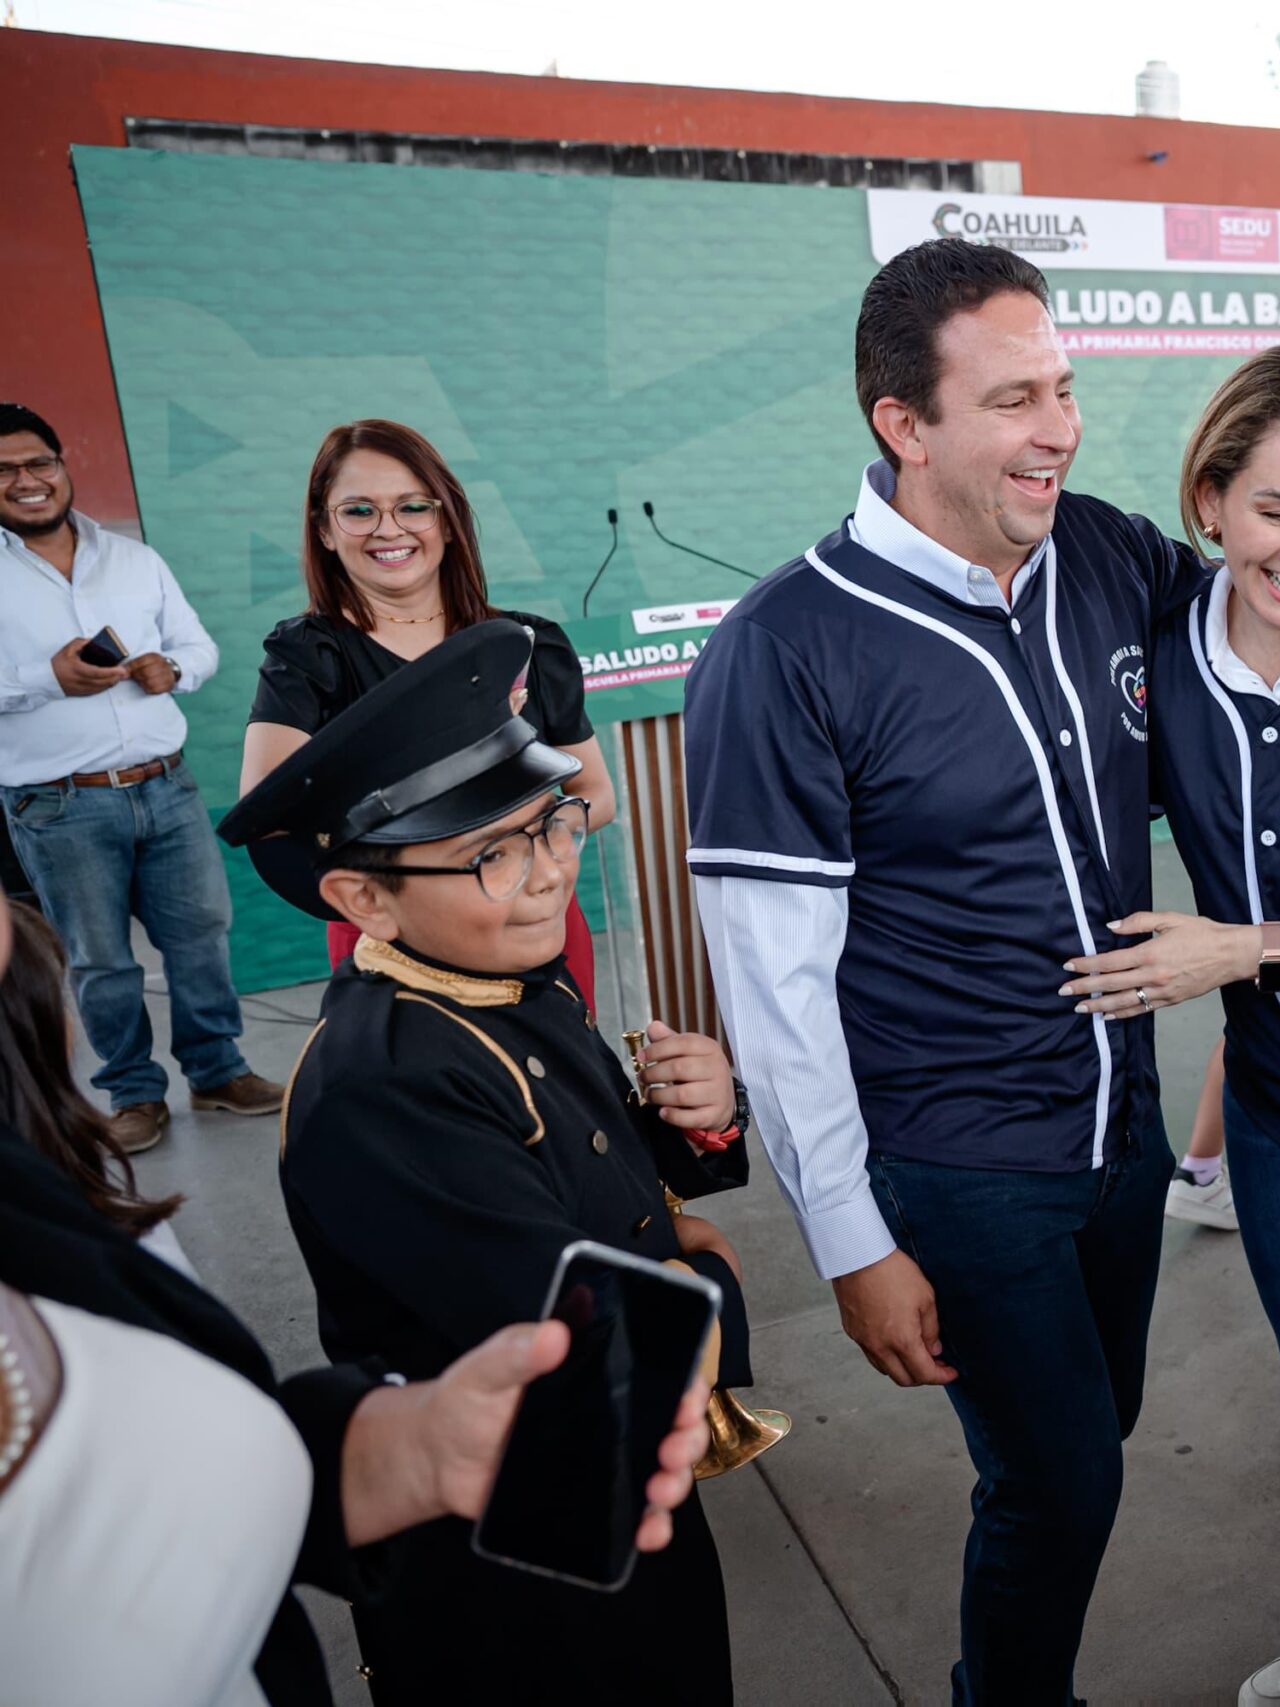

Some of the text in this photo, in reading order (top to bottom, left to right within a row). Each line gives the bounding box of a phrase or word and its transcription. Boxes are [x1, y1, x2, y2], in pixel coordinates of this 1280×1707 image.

[932, 203, 1087, 241] COAHUILA
[1219, 216, 1271, 237] SEDU
[1049, 289, 1162, 324] LUDO
[1167, 291, 1197, 324] A
[1200, 292, 1250, 326] LA
[1082, 335, 1161, 350] PRIMARIA
[1163, 335, 1249, 350] FRANCISCO
[578, 643, 678, 676] SALUDO
[682, 639, 700, 660] A
[585, 671, 629, 689] SCUELA
[630, 664, 681, 682] PRIMARIA
